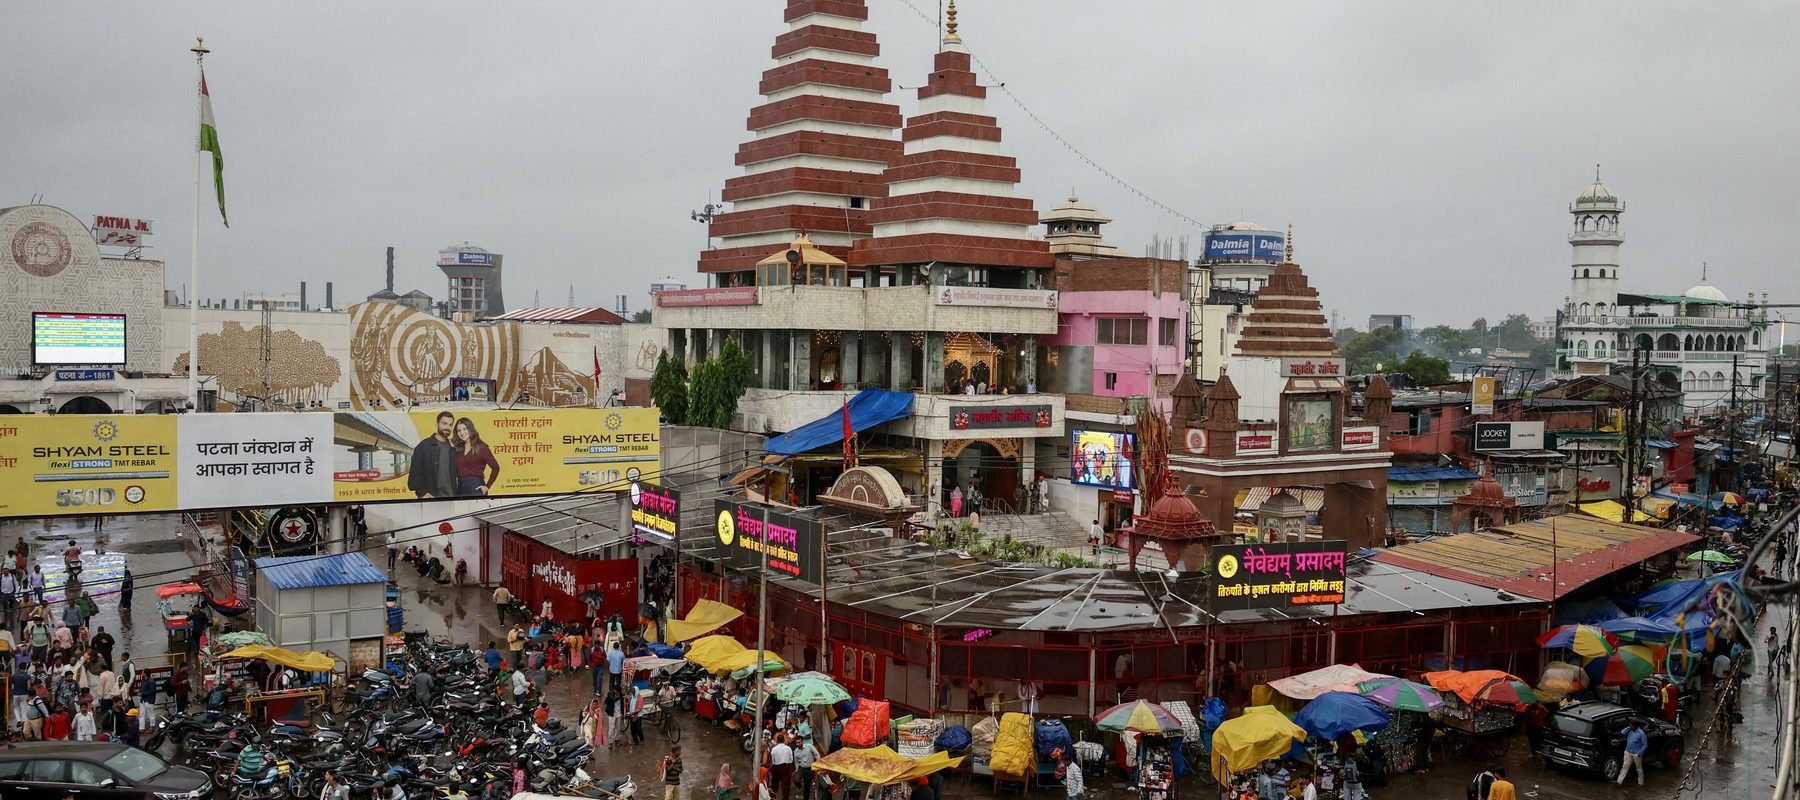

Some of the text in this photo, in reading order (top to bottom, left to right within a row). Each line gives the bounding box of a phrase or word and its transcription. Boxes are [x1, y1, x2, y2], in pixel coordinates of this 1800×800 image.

[97, 216, 131, 229] PATNA
[1211, 239, 1249, 249] Dalmia
[508, 431, 537, 440] मतलब
[562, 433, 659, 444] SHYAM STEEL
[33, 445, 170, 458] SHYAM STEEL
[196, 437, 314, 455] पटना जंक्शन में
[493, 442, 552, 454] हमेशा के लिए
[50, 461, 71, 469] flexi
[196, 456, 315, 476] आपका स्वागत है
[579, 469, 621, 486] 550D
[56, 487, 116, 507] 550D
[1517, 486, 1534, 498] Store
[1243, 547, 1345, 579] नैवेद्यम् प्रसादम्
[1218, 584, 1242, 597] तिरुपति
[1244, 583, 1250, 595] के
